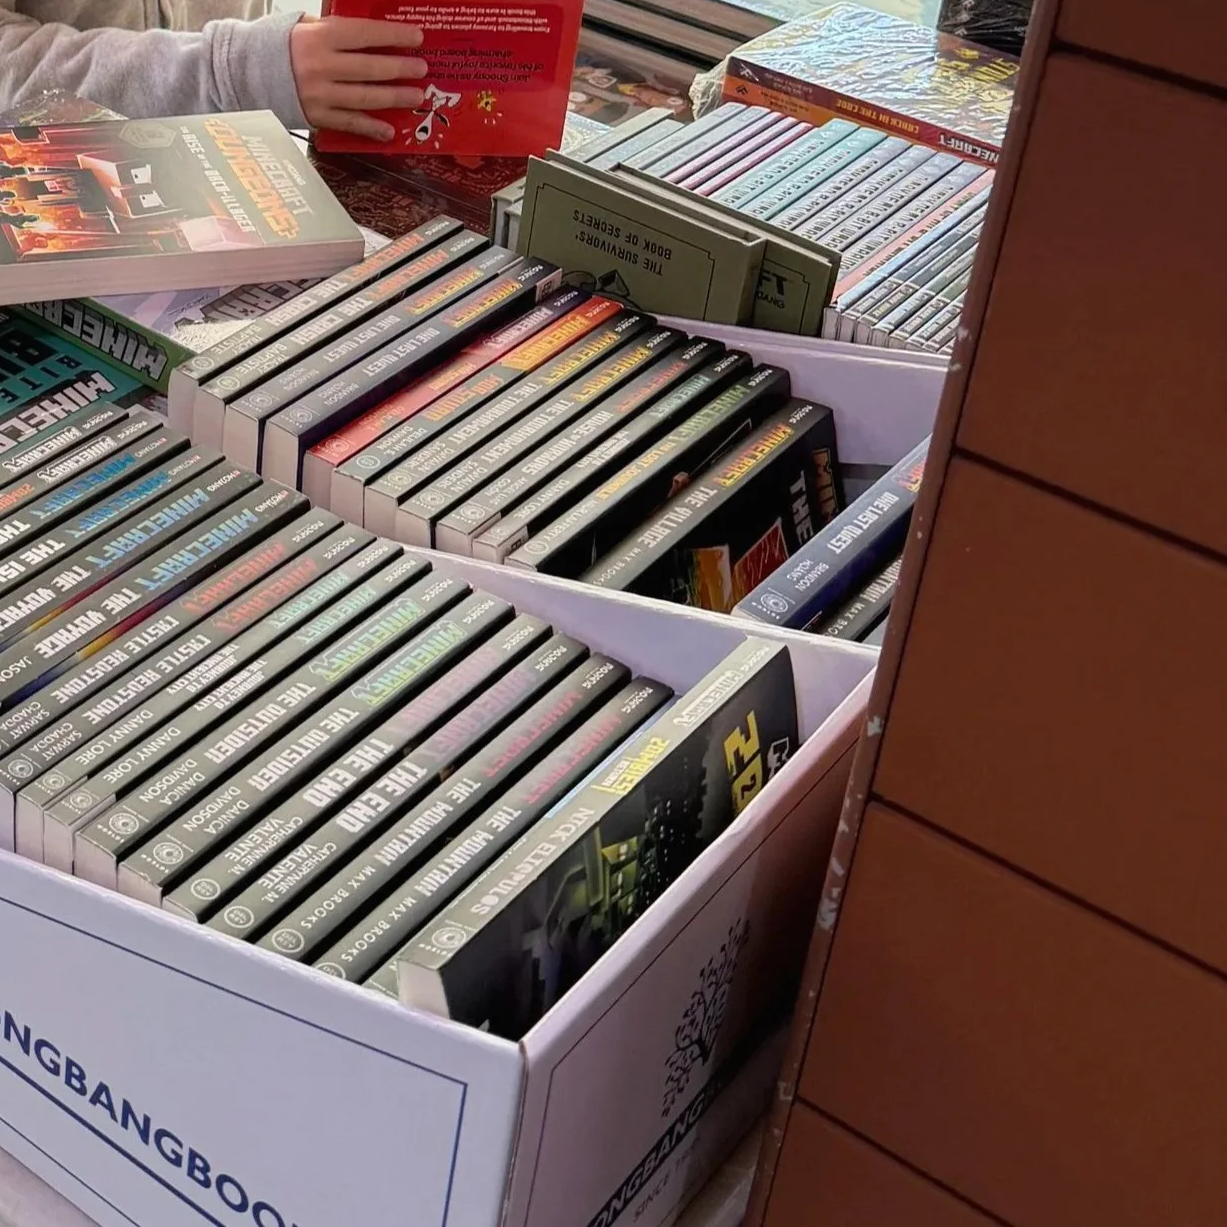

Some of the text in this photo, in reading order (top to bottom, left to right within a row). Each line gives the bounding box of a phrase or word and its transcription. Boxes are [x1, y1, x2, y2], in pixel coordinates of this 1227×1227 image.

[242, 134, 314, 216] MINECRAFT
[935, 132, 1001, 163] NECRAFT
[180, 131, 206, 159] RISE
[204, 168, 257, 234] ARCH-ILLAGER
[204, 118, 299, 240] DUNGEONS
[339, 229, 424, 285] MINECRAFT
[571, 208, 672, 260] BOOK OF SECRETS
[573, 228, 664, 276] THE SURVIVORS'
[235, 245, 449, 378] MINECRAFT THE CRASH TRACEY BAPTISTE
[263, 289, 319, 332] CRASH
[316, 272, 347, 300] THE
[45, 301, 167, 380] MINECR
[209, 319, 263, 359] BAPTISTE
[230, 332, 263, 357] TRACEY
[320, 336, 358, 366] QUEST
[360, 273, 522, 379] MINECRAFT QUEST
[446, 324, 621, 448] MINECRAFT THE TOURNAMENT
[478, 337, 652, 466] MINECRAFT THE TOURNAMENT
[1, 423, 81, 475] MINECRAFT
[35, 432, 116, 485] MINECRAFT
[28, 450, 136, 522] MINECRAFT
[63, 467, 172, 541] MINECRAFT
[635, 418, 795, 552] MINECRAFT THE VILLAGE
[19, 532, 65, 568] THE
[85, 482, 209, 573] MINECRAFT
[130, 502, 259, 596] MINECRAFT
[825, 487, 898, 555] ONE LAST QUEST
[50, 558, 91, 594] THE
[99, 582, 142, 619] THE
[177, 539, 289, 618] MINECRAFT
[793, 559, 829, 593] BRANDON
[28, 556, 320, 761] MINECRAFT CASTLE REDSTONE SARWAT CHADDA
[31, 604, 106, 662] VOYAGE
[124, 611, 180, 655] CASTLE
[47, 644, 131, 706] REDSTONE
[73, 568, 351, 768] MINECRAFT DANNY LORE
[101, 582, 378, 786] MINECRAFT DANNY LORE
[195, 652, 239, 686] JOURNEY
[223, 668, 266, 702] JOURNEY
[246, 655, 268, 674] THE
[7, 706, 51, 740] SARWAT
[137, 595, 423, 809] MINECRAFT THE OUTSIDER DANICA DAVIDSON
[180, 618, 465, 838] MINECRAFT THE OUTSIDER DANICA DAVIDSON
[225, 730, 394, 865] THE END CATHERYNNE VALENTE
[443, 770, 482, 807] THE
[484, 799, 522, 835] THE
[256, 752, 427, 893] THE END CATHERYNNE VALENTE
[372, 795, 452, 868] MOUNTAIN
[343, 862, 375, 892] MAX
[412, 824, 493, 901] MOUNTAIN
[469, 801, 596, 921] NICK ELIOPULOS
[297, 885, 349, 932] BROOKS
[385, 893, 417, 923] MAX
[338, 917, 391, 965] BROOKS
